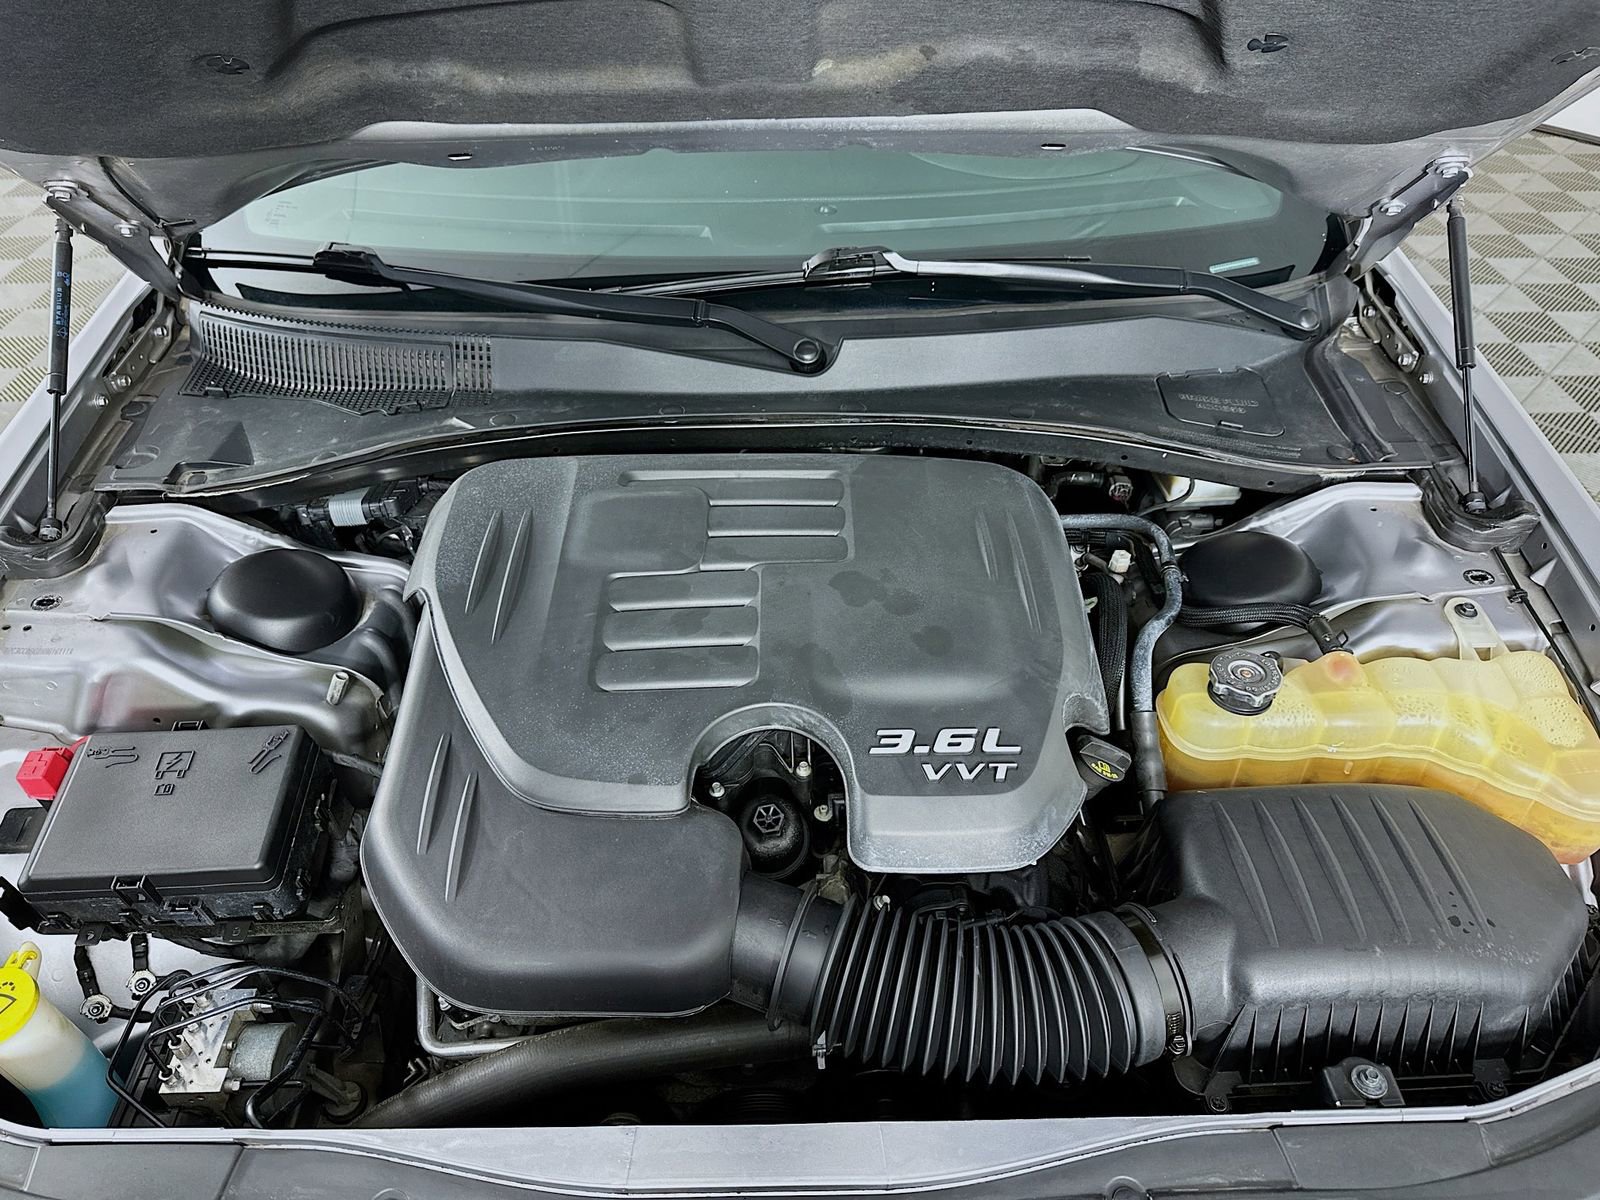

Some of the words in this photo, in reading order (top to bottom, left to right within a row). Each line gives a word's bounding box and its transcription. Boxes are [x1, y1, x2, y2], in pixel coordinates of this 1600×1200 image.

[55, 287, 63, 325] STABILUS
[869, 727, 1022, 755] 3.6L
[921, 763, 1018, 783] VVT
